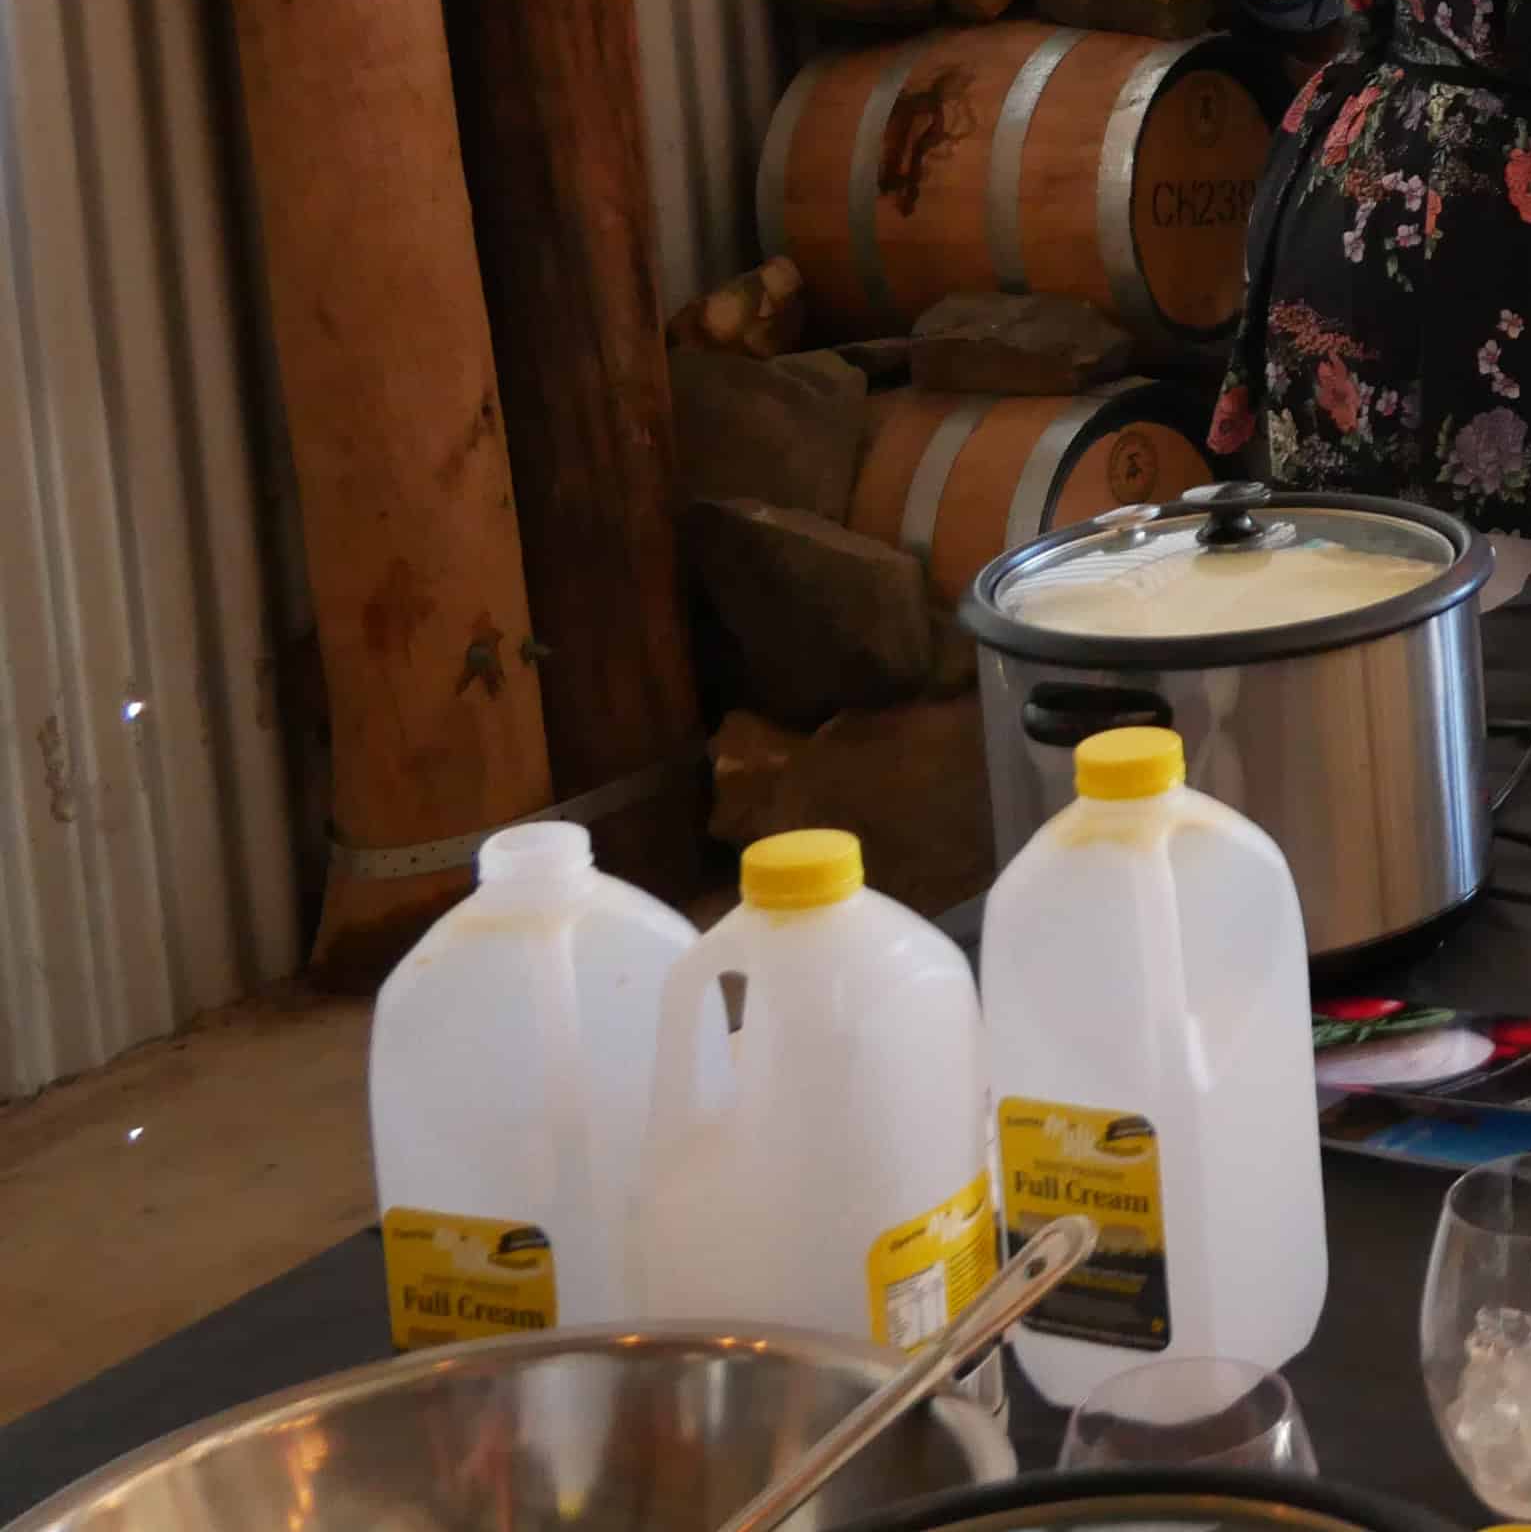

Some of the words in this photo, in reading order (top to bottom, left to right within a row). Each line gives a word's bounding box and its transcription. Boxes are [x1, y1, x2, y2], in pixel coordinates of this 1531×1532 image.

[1014, 1171, 1059, 1201] Full
[1065, 1179, 1150, 1214] Cream
[402, 1286, 450, 1316] Full
[457, 1294, 547, 1330] Cream
